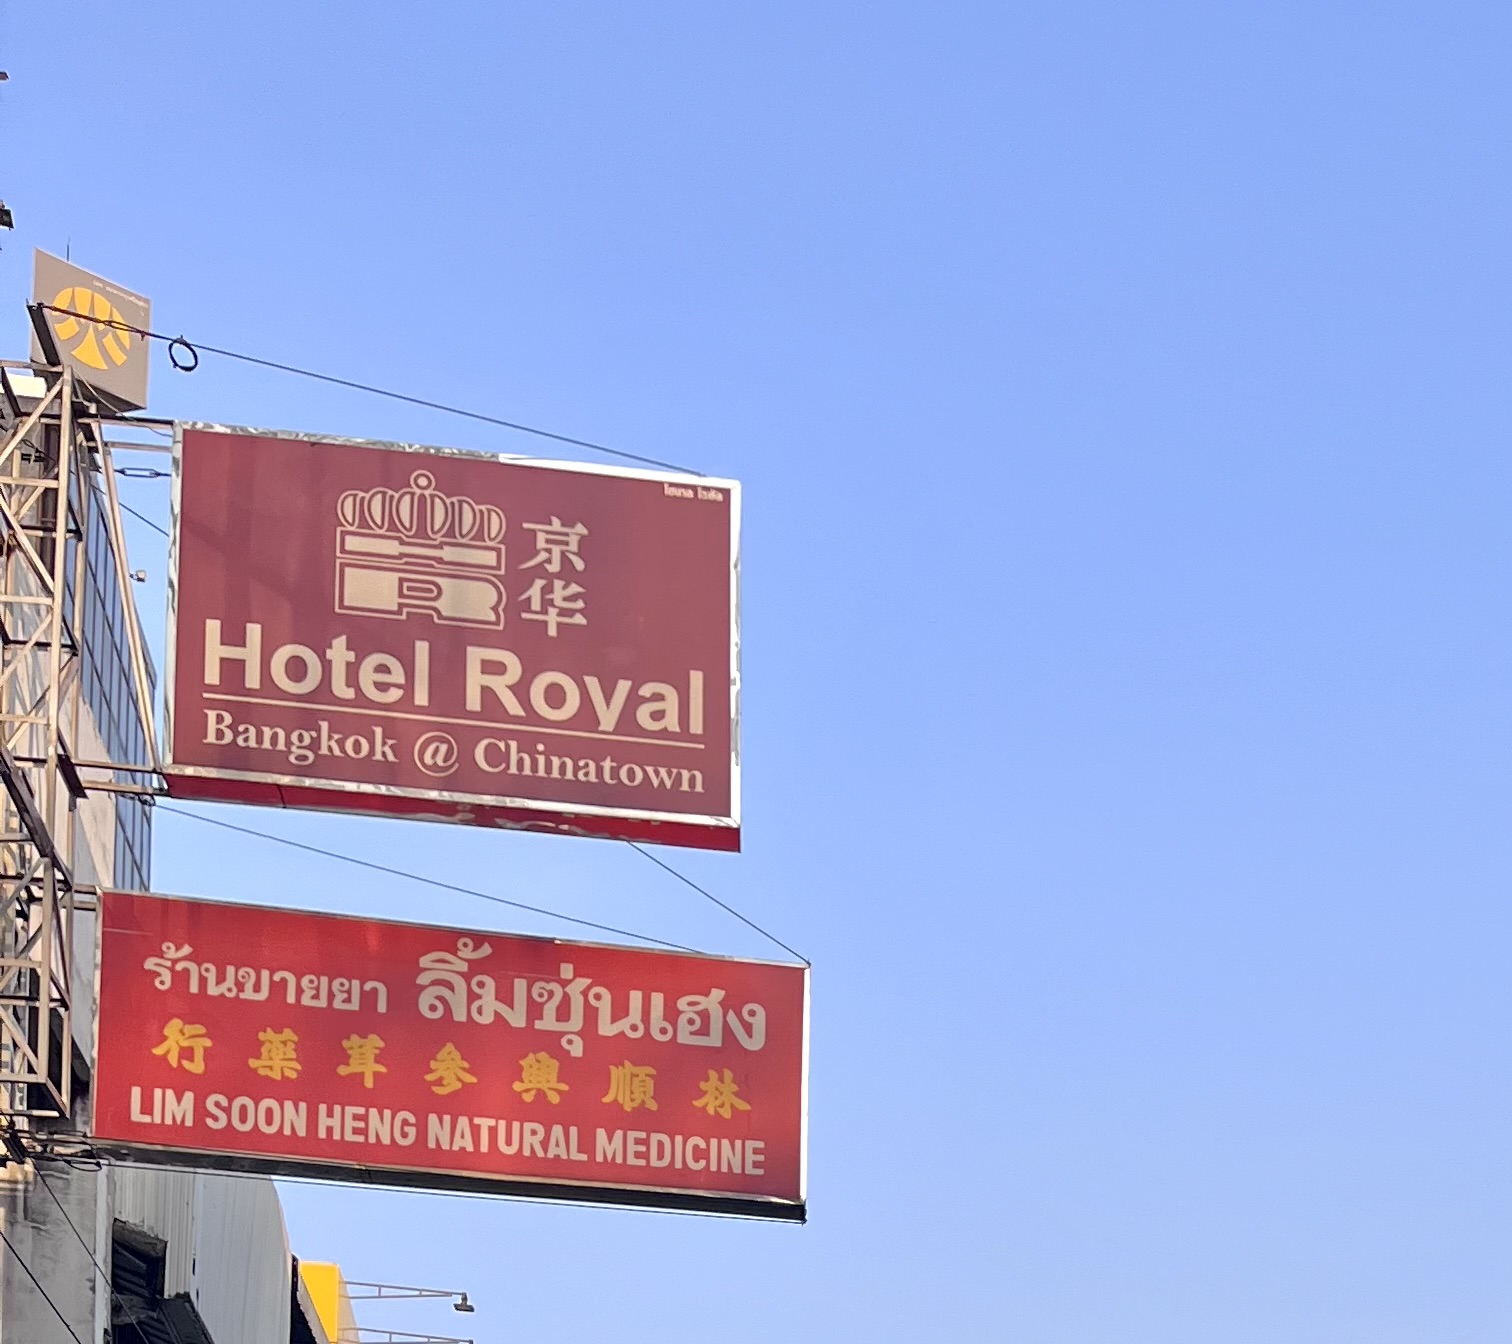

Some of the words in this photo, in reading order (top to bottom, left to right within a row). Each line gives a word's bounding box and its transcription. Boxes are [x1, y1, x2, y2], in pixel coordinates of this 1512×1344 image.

[204, 619, 429, 706] Hotel
[465, 646, 704, 735] Royal
[202, 710, 399, 765] Bangkok
[414, 732, 459, 776] @
[474, 738, 704, 793] Chinatown
[144, 942, 388, 1013] ร้านขายยา
[130, 1086, 195, 1127] LIM
[205, 1094, 307, 1137] SOON
[317, 1103, 417, 1145] HENG
[427, 1113, 588, 1162] NATURAL
[595, 1127, 766, 1175] MEDICINE
